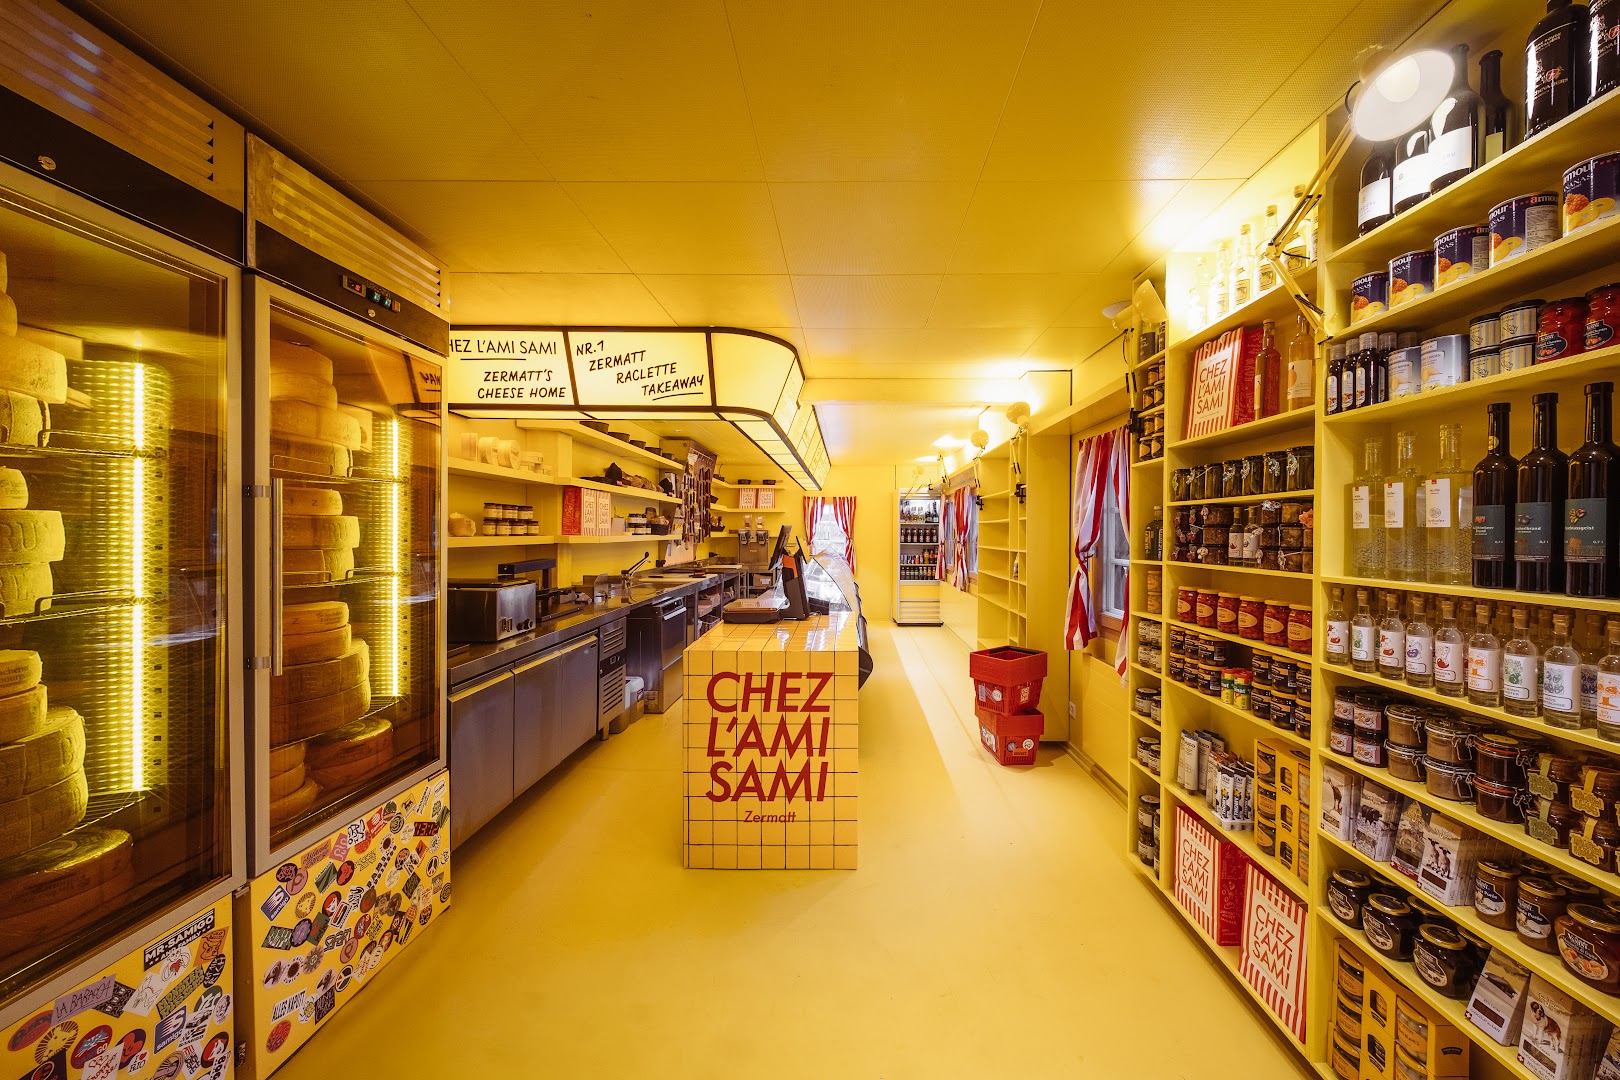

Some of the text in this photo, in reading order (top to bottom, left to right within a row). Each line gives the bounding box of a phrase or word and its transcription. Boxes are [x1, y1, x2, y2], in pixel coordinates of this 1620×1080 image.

[1563, 160, 1598, 184] rmour
[1564, 174, 1594, 192] NANAS
[1489, 205, 1509, 219] mour
[1437, 232, 1458, 246] mour
[1392, 255, 1414, 267] mour
[1352, 274, 1374, 288] rmour
[449, 339, 556, 354] HEZ L'AMI SAMI
[589, 350, 646, 372] ZERMATT
[1199, 358, 1229, 383] CHEZ
[483, 368, 553, 382] ZERMATT'S
[616, 362, 677, 384] RACLETTE
[477, 387, 567, 399] CHEESE HOME
[641, 374, 704, 396] TAKEAWAY
[1197, 375, 1226, 399] L'AMI
[1196, 391, 1224, 415] SAMI
[706, 671, 834, 713] CHEZ
[706, 713, 830, 760] L'AMI
[705, 758, 829, 805] SAMI
[743, 810, 797, 823] Zermatt
[1182, 838, 1210, 874] CHEZ
[1181, 853, 1209, 887] L'AMI
[1181, 869, 1208, 906] SAMI
[1255, 904, 1295, 952] CHEZ
[1253, 921, 1293, 971] L'AMI
[1252, 942, 1290, 991] SAMI
[56, 1002, 67, 1019] LA
